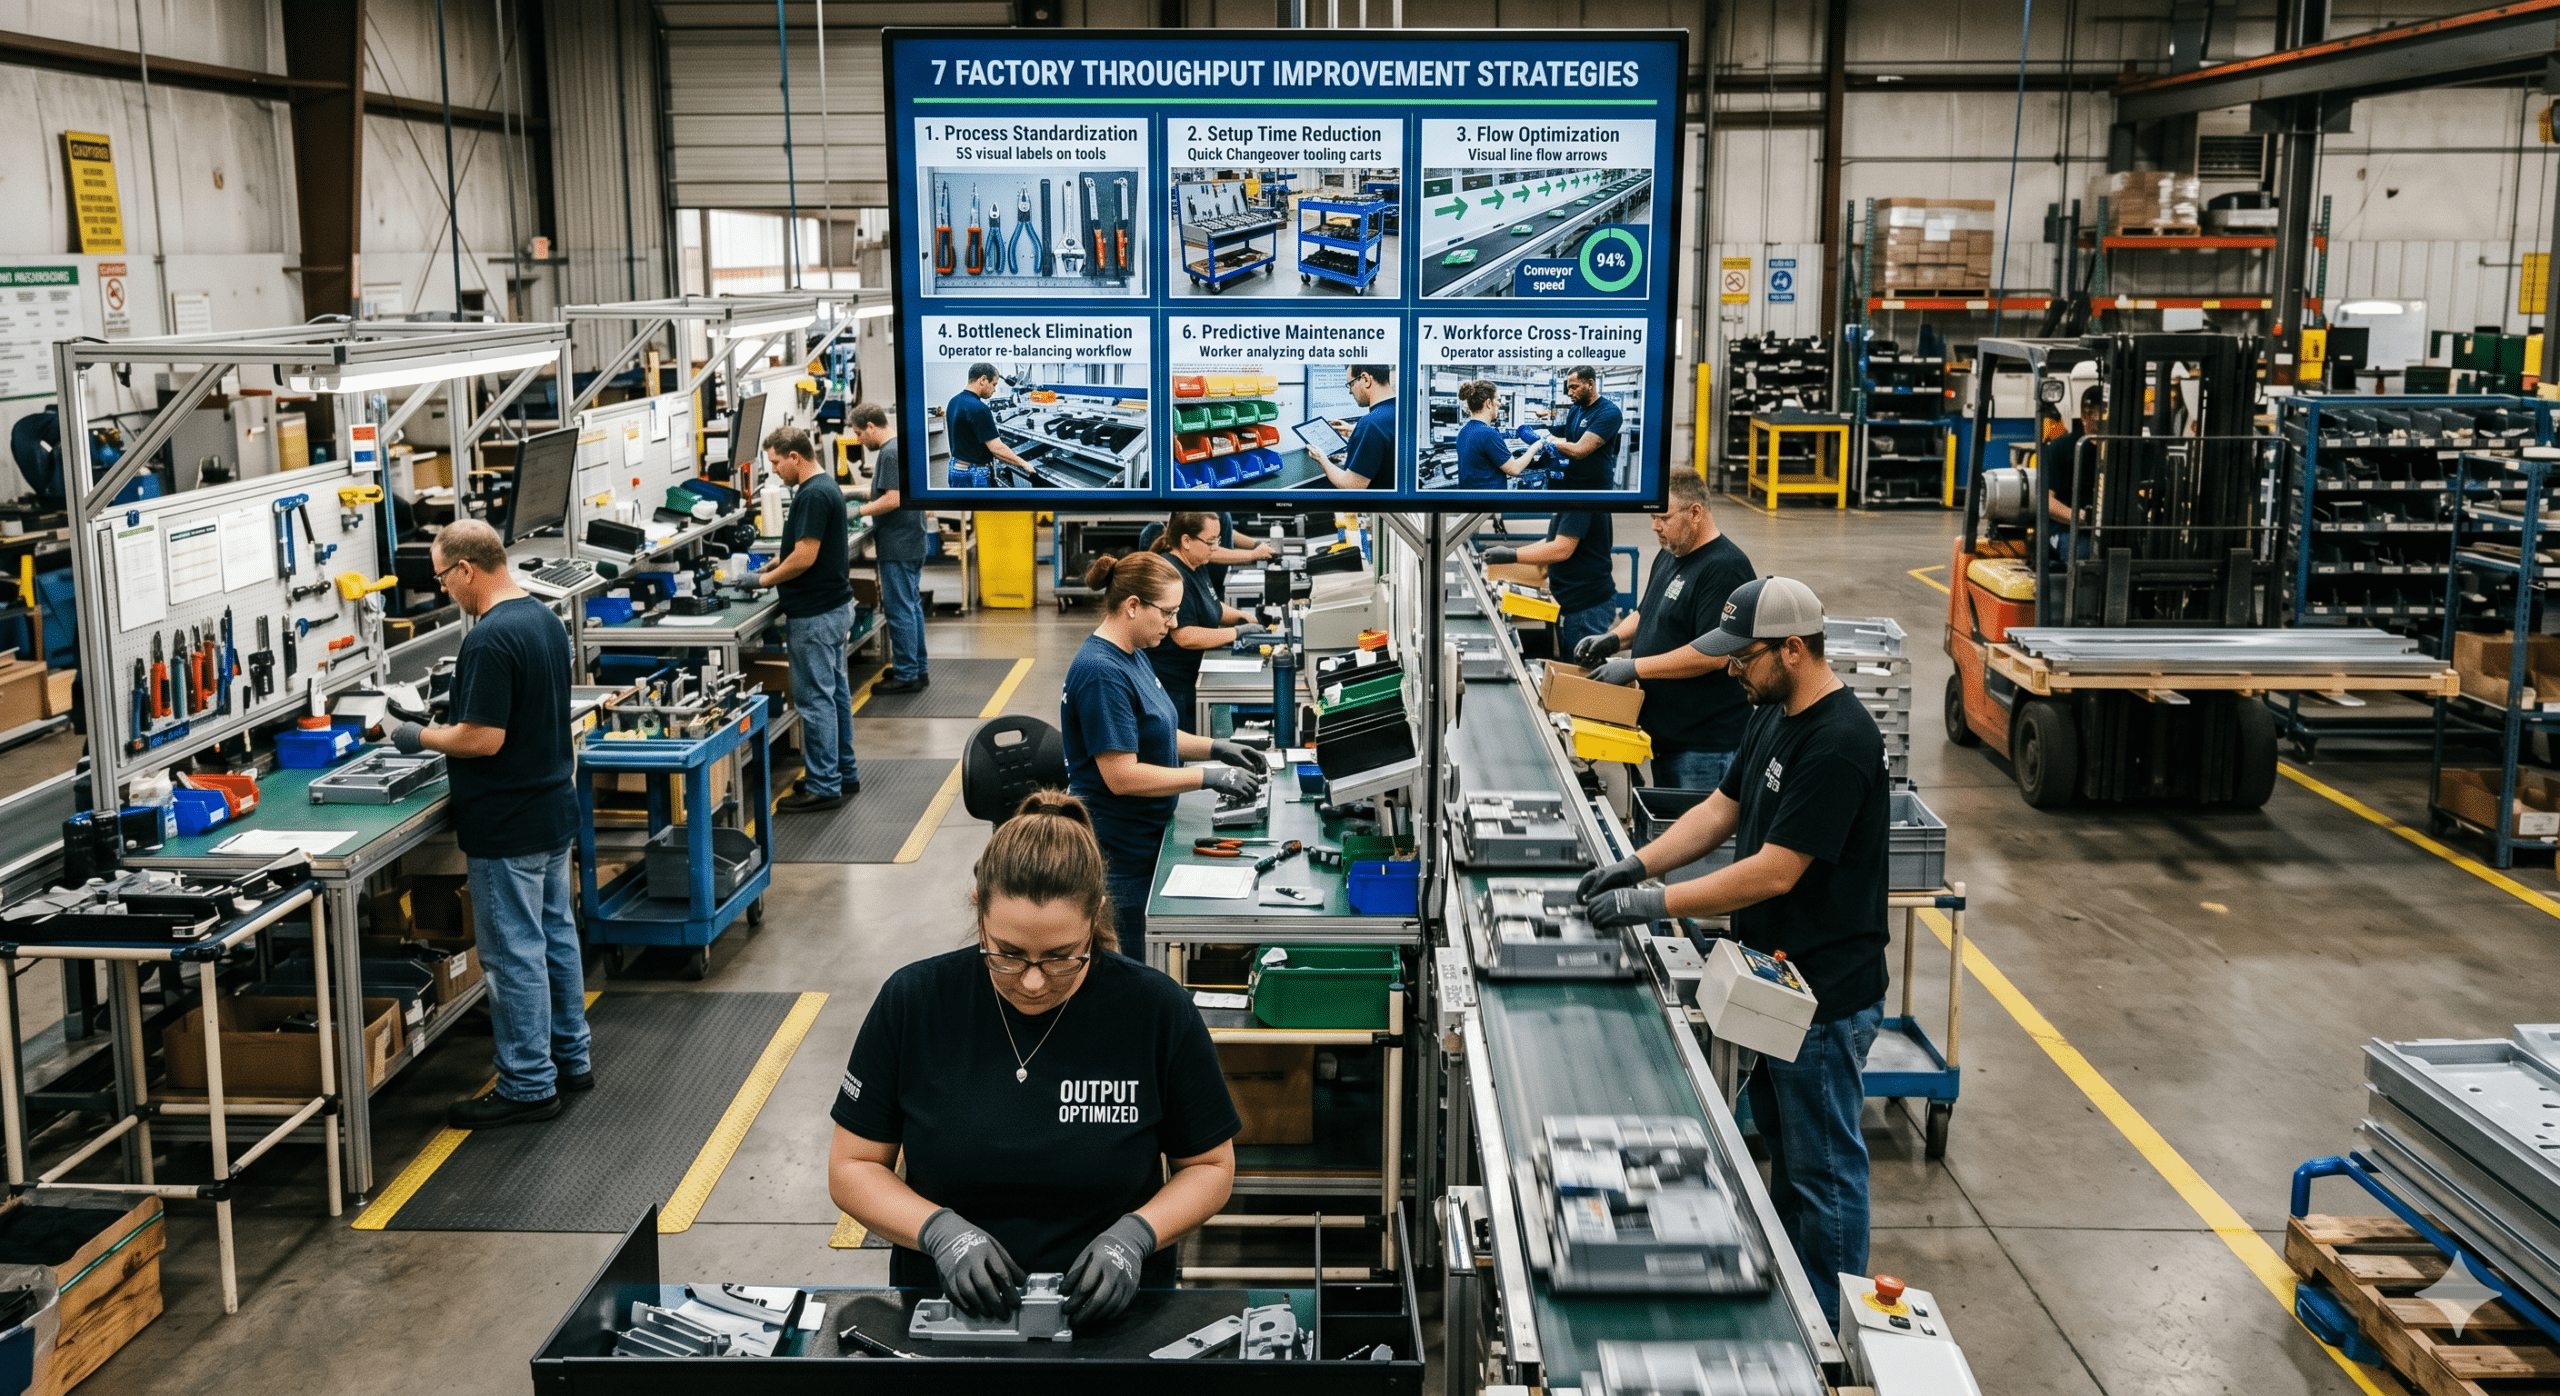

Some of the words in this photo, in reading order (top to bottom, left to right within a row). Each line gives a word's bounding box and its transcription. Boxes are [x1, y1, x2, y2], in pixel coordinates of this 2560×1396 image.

[931, 59, 947, 85] 7
[955, 59, 1075, 86] FACTORY
[1081, 59, 1266, 87] THROUGHPUT
[1273, 60, 1471, 87] IMPROVEMENT
[1477, 60, 1639, 87] STRATEGIES
[925, 125, 939, 141] 1.
[944, 124, 1008, 141] Process
[1013, 124, 1138, 142] Standardization
[1187, 125, 1202, 142] 2.
[1207, 125, 1254, 146] Setup
[1257, 125, 1297, 142] Time
[1302, 124, 1381, 142] Reduction
[1456, 125, 1472, 142] 3.
[1477, 125, 1514, 142] Flow
[1518, 125, 1620, 147] Optimization
[956, 146, 973, 160] 5S
[975, 145, 1012, 160] visual
[1015, 146, 1053, 160] labels
[1056, 149, 1072, 160] on
[1074, 146, 1107, 160] tools
[1187, 146, 1223, 162] Quick
[1226, 147, 1300, 164] Changeover
[1303, 147, 1347, 165] tooling
[1349, 148, 1382, 161] carts
[1467, 147, 1507, 161] Visual
[1510, 147, 1533, 161] line
[1535, 147, 1563, 162] flow
[1565, 151, 1608, 162] arrows
[1595, 252, 1627, 268] 94%
[1523, 264, 1574, 279] Conveyor
[1532, 279, 1566, 293] speed
[937, 323, 952, 338] 4.
[957, 322, 1041, 339] Bottleneck
[1045, 322, 1133, 339] Elimination
[1182, 324, 1197, 340] 6.
[1202, 323, 1281, 340] Predictive
[1285, 324, 1385, 340] Maintenance
[1423, 324, 1438, 340] 7.
[1443, 324, 1523, 341] Workforce
[1527, 324, 1642, 345] Cross-Training
[938, 344, 993, 360] Operator
[995, 344, 1073, 360] re-balancing
[1075, 344, 1132, 357] workflow
[1199, 344, 1244, 358] Worker
[1246, 344, 1305, 361] analyzing
[1308, 345, 1335, 358] data
[1440, 345, 1495, 361] Operator
[1497, 345, 1553, 362] assisting
[1556, 349, 1564, 359] a
[1567, 345, 1627, 362] colleague
[1060, 1079, 1140, 1104] OUTPUT
[1058, 1105, 1139, 1124] OPTIMIZED
